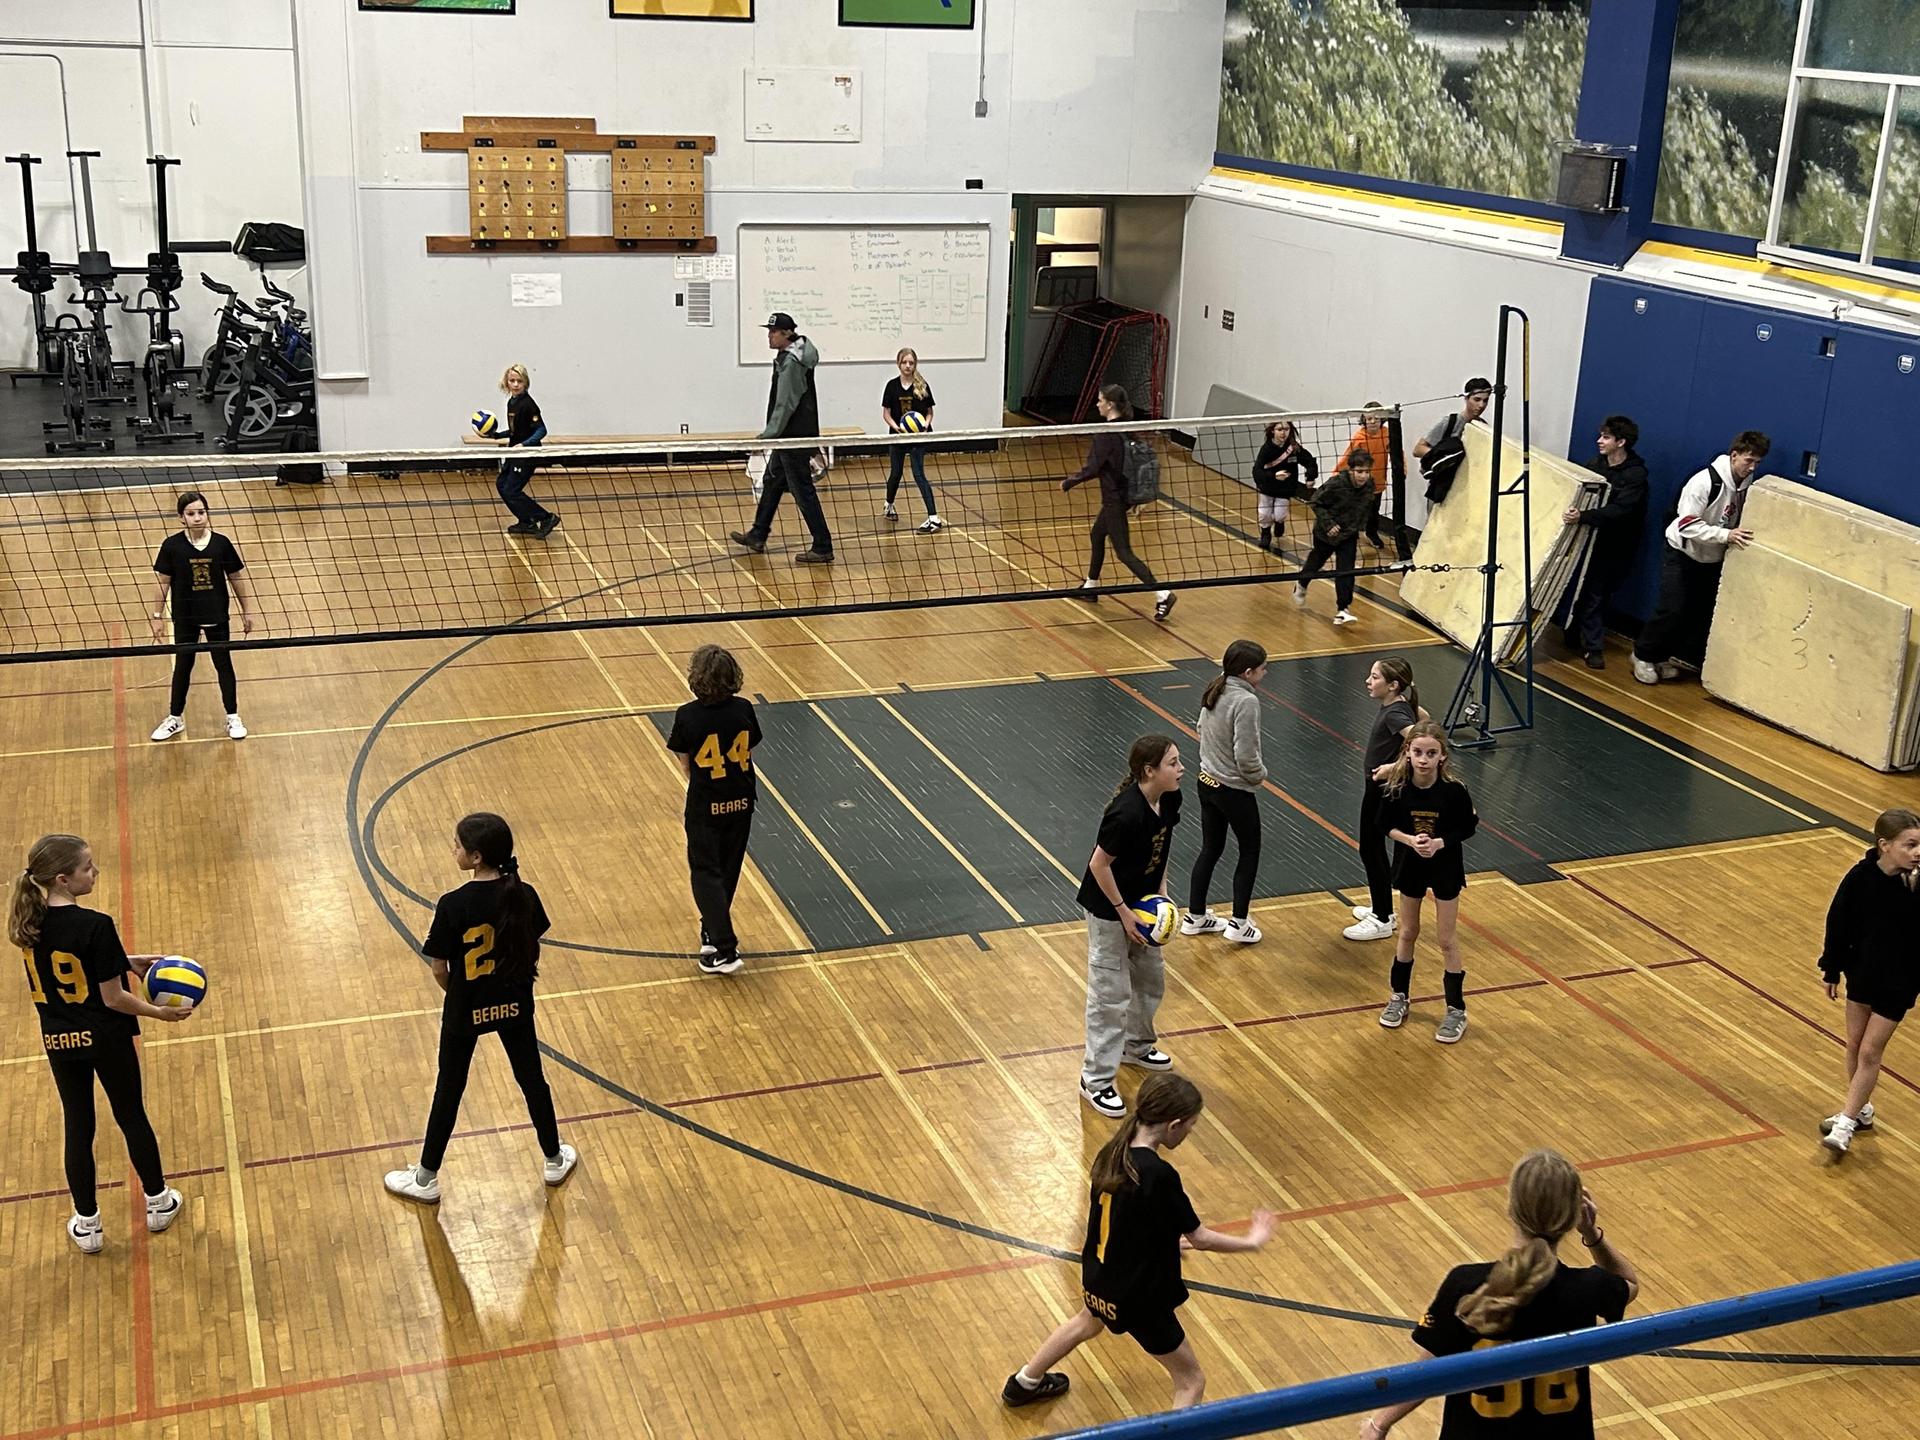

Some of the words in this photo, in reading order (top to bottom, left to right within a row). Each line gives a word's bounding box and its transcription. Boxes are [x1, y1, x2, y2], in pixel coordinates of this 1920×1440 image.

[1791, 637, 1809, 670] 3
[694, 730, 752, 780] 44
[711, 798, 748, 815] BEARS
[462, 922, 496, 981] 2
[23, 948, 90, 1004] 19
[472, 1003, 520, 1025] BEARS
[44, 1030, 93, 1050] BEARS
[1096, 1191, 1113, 1264] 1
[1082, 1288, 1117, 1321] EARS
